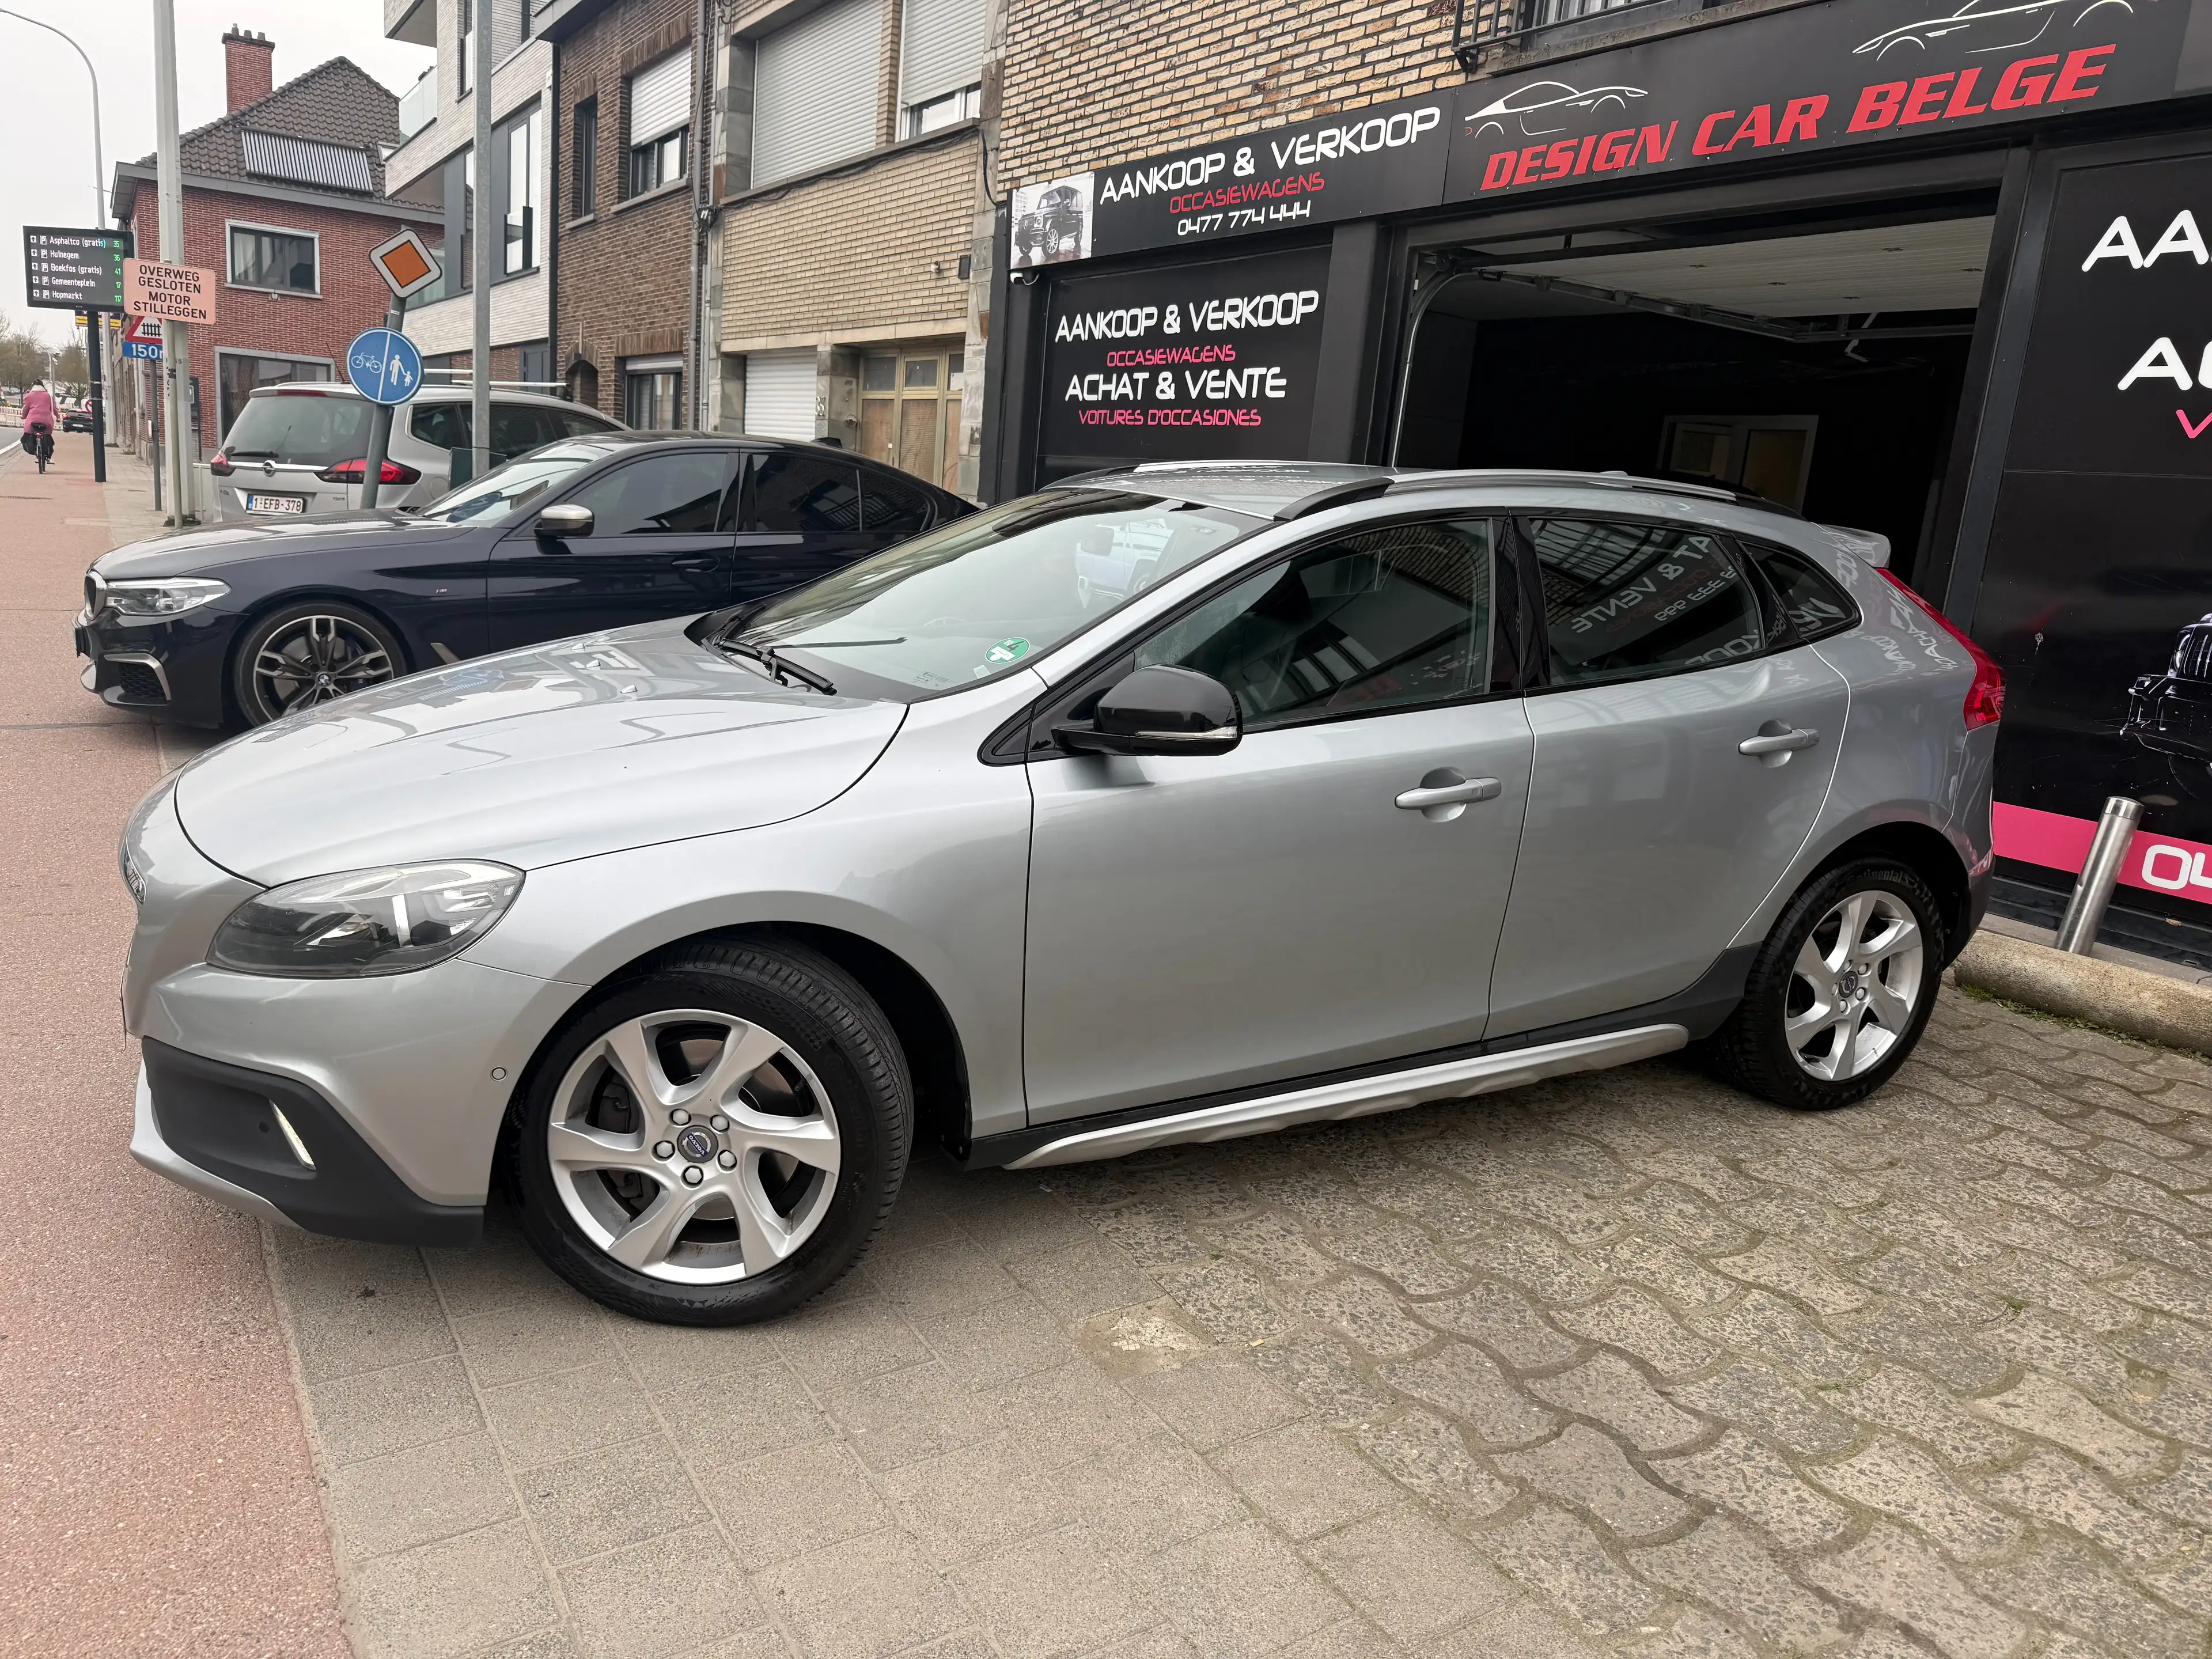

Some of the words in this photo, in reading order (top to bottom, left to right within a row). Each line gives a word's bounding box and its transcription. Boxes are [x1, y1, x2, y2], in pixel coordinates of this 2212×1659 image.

[1480, 120, 1679, 191] DESIGN
[1692, 94, 1830, 156] CAR
[1846, 44, 2116, 133] BELGE
[1100, 152, 1226, 205] AANKOOP
[1233, 146, 1255, 177] &
[1271, 107, 1441, 169] VERKOOP
[1169, 172, 1325, 214] OCCASIEWAGENS
[1177, 213, 1224, 236] 0477
[1228, 207, 1266, 229] 774
[1269, 199, 1311, 222] 444
[50, 236, 79, 245] Asphaltco
[82, 238, 106, 248] (gratis)
[2081, 210, 2212, 272] AA
[50, 249, 79, 260] Huinegem
[51, 263, 76, 272] Boekfos
[78, 265, 102, 275] (gratis)
[139, 264, 200, 282] OVERWEG
[51, 276, 96, 287] Gemeenteplein
[138, 276, 201, 294] GESLOTEN
[52, 290, 82, 300] Hopmarkt
[149, 291, 191, 306] MOTOR
[133, 301, 207, 320] STILLEGGEN
[1055, 306, 1158, 343] AANKOOP
[1163, 304, 1181, 334] &
[1189, 290, 1319, 332] VERKOOP
[1107, 344, 1236, 367] OCCASIEWAGENS
[2117, 337, 2212, 391] A
[1065, 372, 1150, 402] ACHAT
[1156, 371, 1176, 400] &
[1184, 366, 1287, 399] VENTE
[1079, 409, 1144, 426] VOITURES
[1147, 408, 1262, 426] D'OCCASIONES
[688, 1135, 705, 1156] VOLVO
